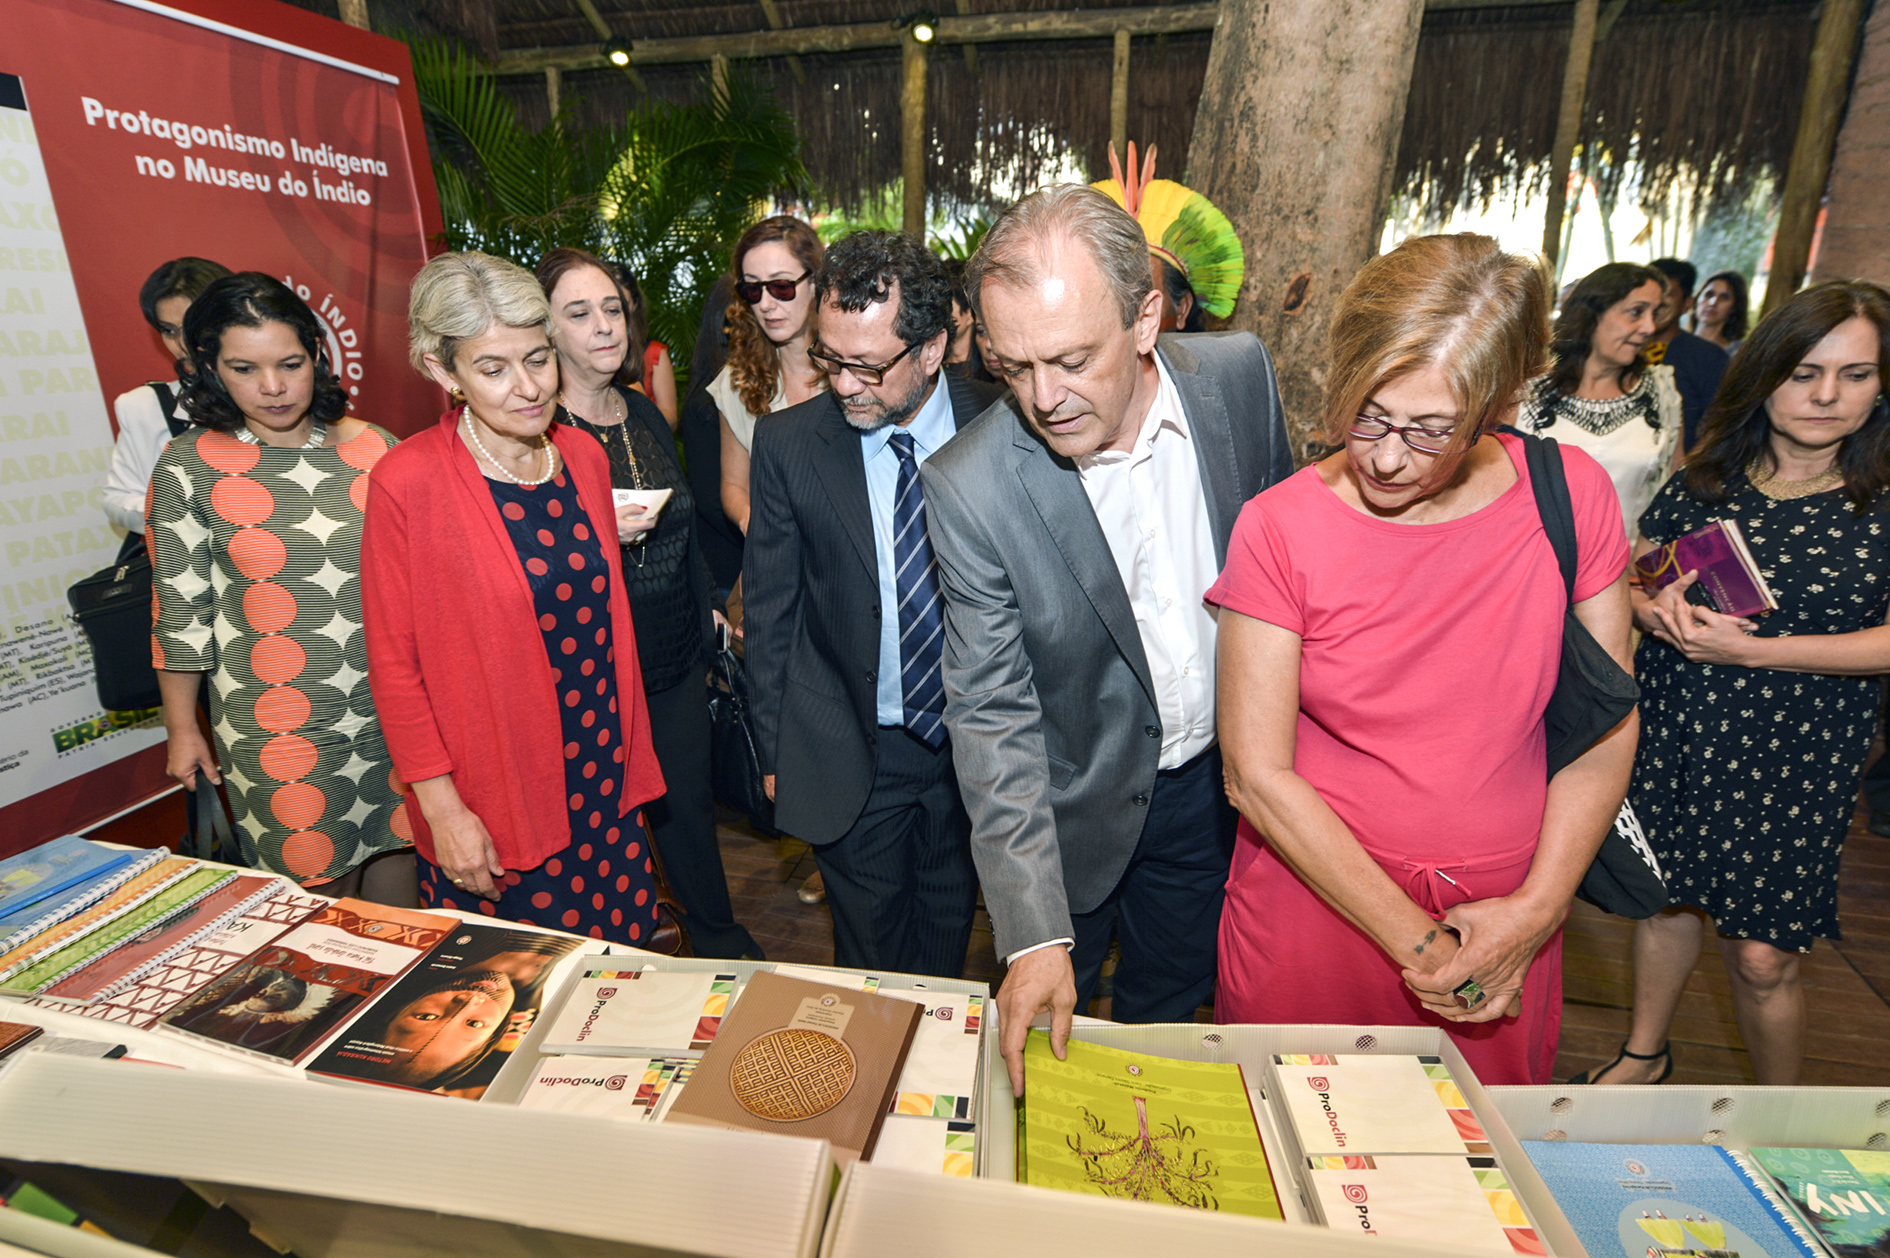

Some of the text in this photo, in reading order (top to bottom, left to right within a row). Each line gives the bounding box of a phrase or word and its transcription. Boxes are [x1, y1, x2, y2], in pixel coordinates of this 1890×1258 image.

[81, 96, 388, 178] Protagonismo Indígena
[135, 154, 371, 206] no Museu do Índio
[320, 293, 364, 381] ÍNDIO
[576, 1000, 607, 1042] ProDoclin
[539, 1075, 605, 1088] ProDoclin
[1318, 1092, 1346, 1148] ProDoclin
[1806, 1182, 1887, 1217] INY
